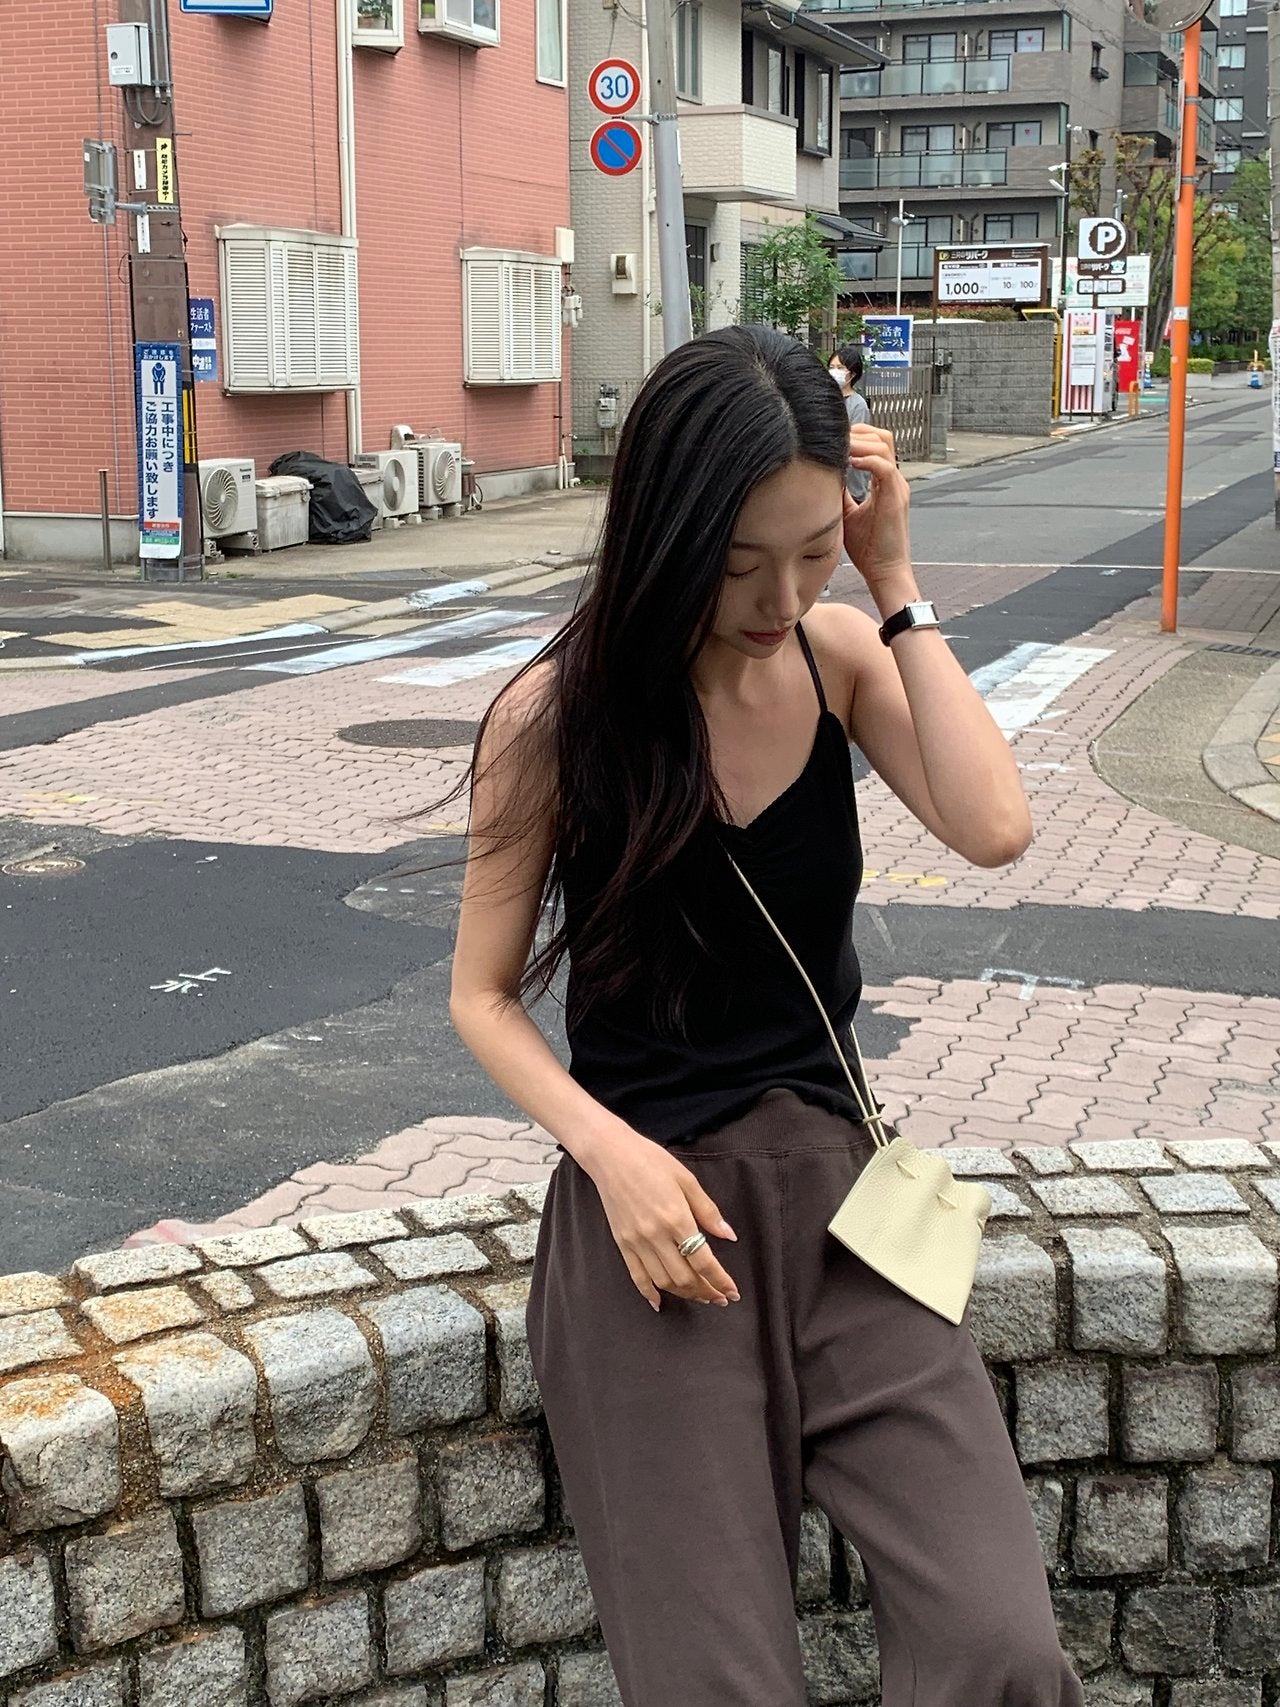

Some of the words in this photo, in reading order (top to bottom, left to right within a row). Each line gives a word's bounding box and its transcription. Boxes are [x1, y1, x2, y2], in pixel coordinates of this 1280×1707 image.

[600, 75, 628, 99] 30
[1097, 226, 1117, 252] P
[945, 282, 979, 295] 1,000
[190, 307, 209, 320] 生活者
[190, 321, 212, 333] ファースト
[868, 338, 905, 348] フースト
[161, 401, 174, 473] 工事中につき
[145, 401, 158, 519] ご協力お願い致します
